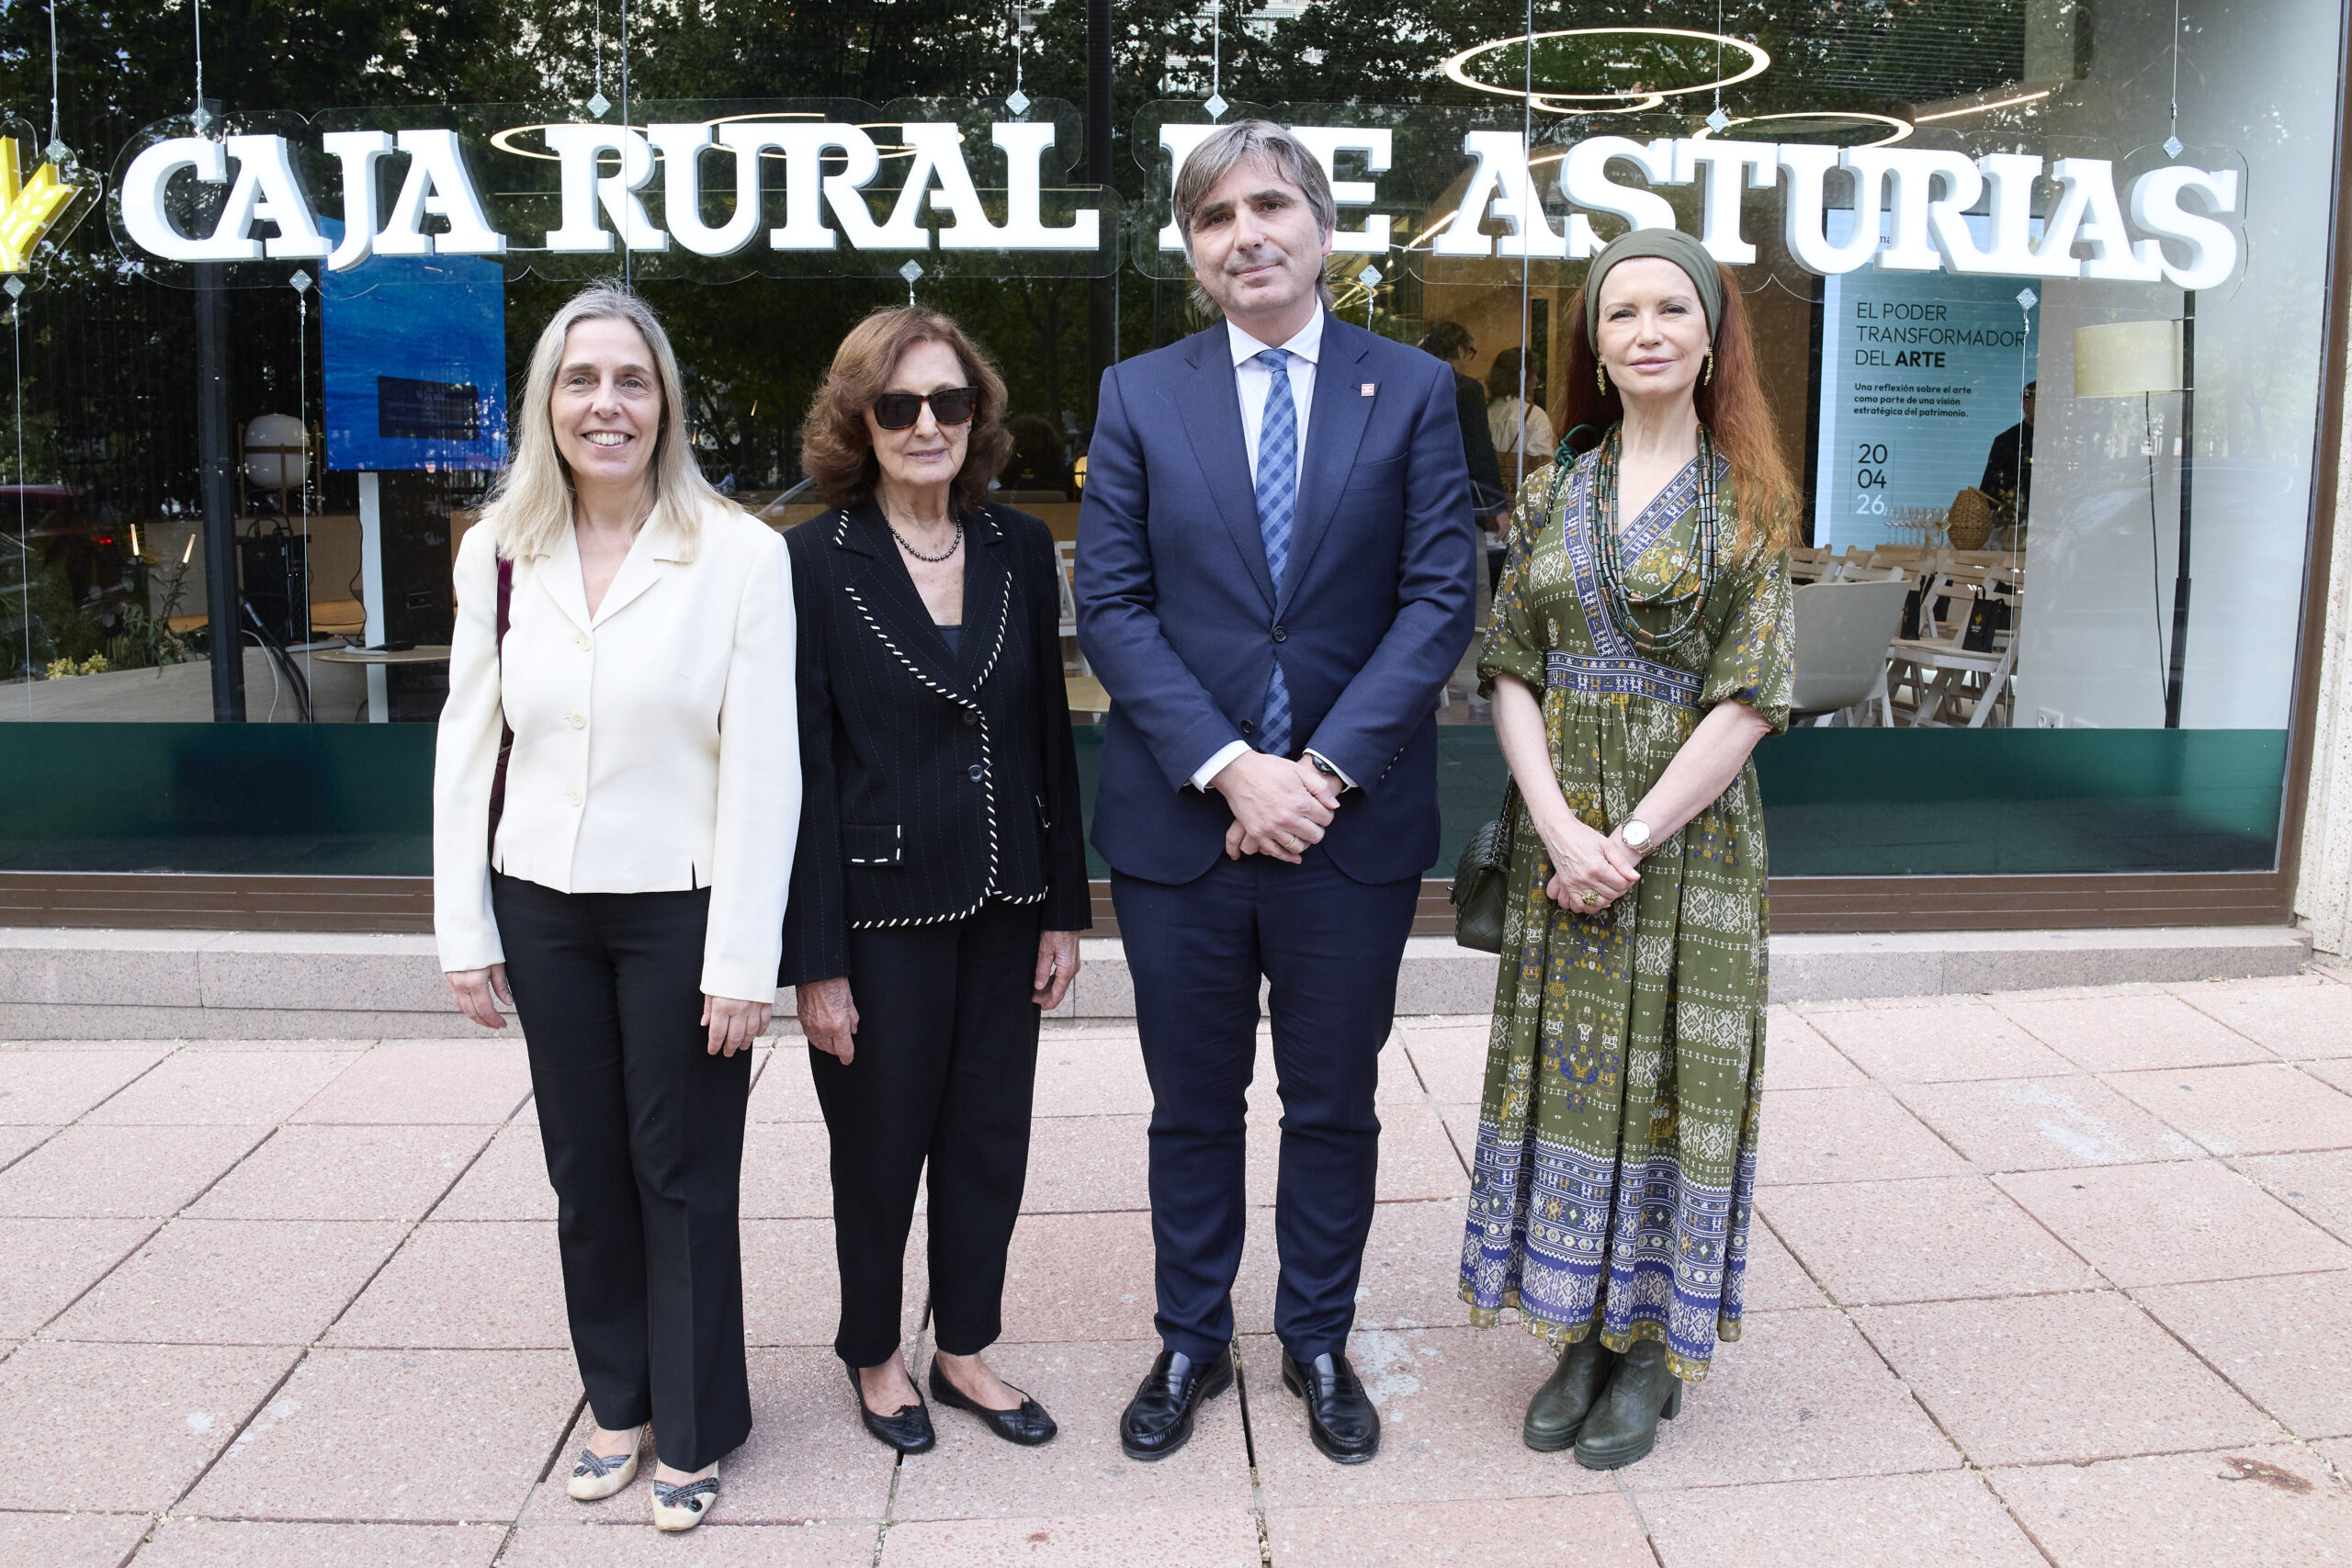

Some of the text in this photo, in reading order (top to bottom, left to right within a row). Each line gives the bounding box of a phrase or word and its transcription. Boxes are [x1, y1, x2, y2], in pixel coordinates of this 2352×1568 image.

[121, 122, 2237, 290] CAJA RURAL E ASTURIAS
[1858, 302, 1947, 321] EL PODER
[1856, 325, 2025, 347] TRANSFORMADOR
[1856, 349, 1946, 367] DEL ARTE
[1855, 383, 1972, 394] Una reflexión sobre el arte
[1880, 396, 1905, 405] parte
[1906, 396, 1917, 404] de
[1936, 397, 1961, 405] visión
[1854, 407, 1903, 416] estratégica
[1919, 409, 1968, 417] patrimonio.
[1858, 443, 1888, 464] 20
[1857, 468, 1887, 490] 04
[1856, 493, 1885, 514] 26
